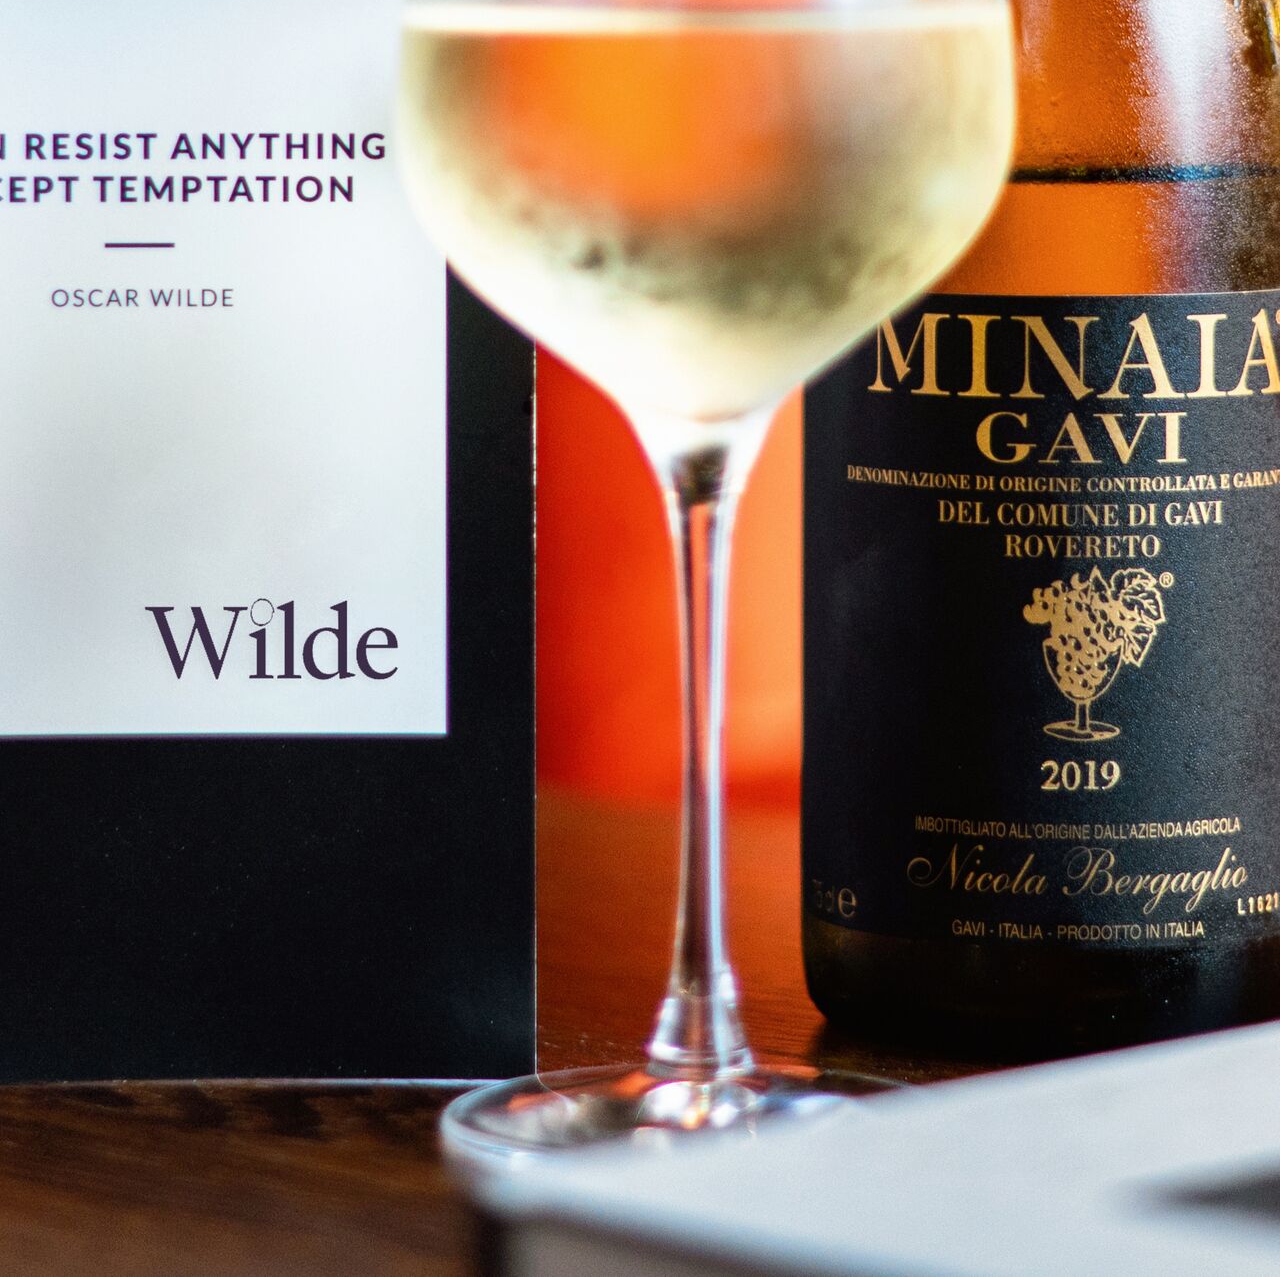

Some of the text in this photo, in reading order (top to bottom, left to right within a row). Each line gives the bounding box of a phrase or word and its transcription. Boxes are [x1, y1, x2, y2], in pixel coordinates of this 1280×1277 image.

[24, 133, 158, 160] RESIST
[170, 133, 387, 160] ANYTHING
[92, 175, 355, 203] TEMPTATION
[50, 288, 234, 308] OSCAR WILDE
[975, 410, 1188, 465] GAVI
[846, 464, 970, 490] DENOMINAZIONE
[975, 475, 995, 491] DI
[999, 476, 1081, 493] ORIGINE
[1086, 474, 1217, 493] CONTROLLATA
[1220, 473, 1231, 489] E
[937, 499, 1223, 527] DEL COMUNE DI GAVI
[1003, 534, 1162, 558] ROVERETO
[145, 597, 399, 681] Wilde
[1039, 759, 1122, 792] 2019
[914, 815, 1006, 838] IMBOTTIGLIATO
[1184, 816, 1240, 836] AGRICOLA
[907, 842, 1249, 915] Nicola Bergaglio
[952, 919, 986, 937] GAVI
[998, 921, 1043, 940] ITALIA
[1056, 923, 1142, 941] PRODOTTO
[1145, 922, 1161, 939] IN
[1163, 920, 1205, 939] ITALIA
